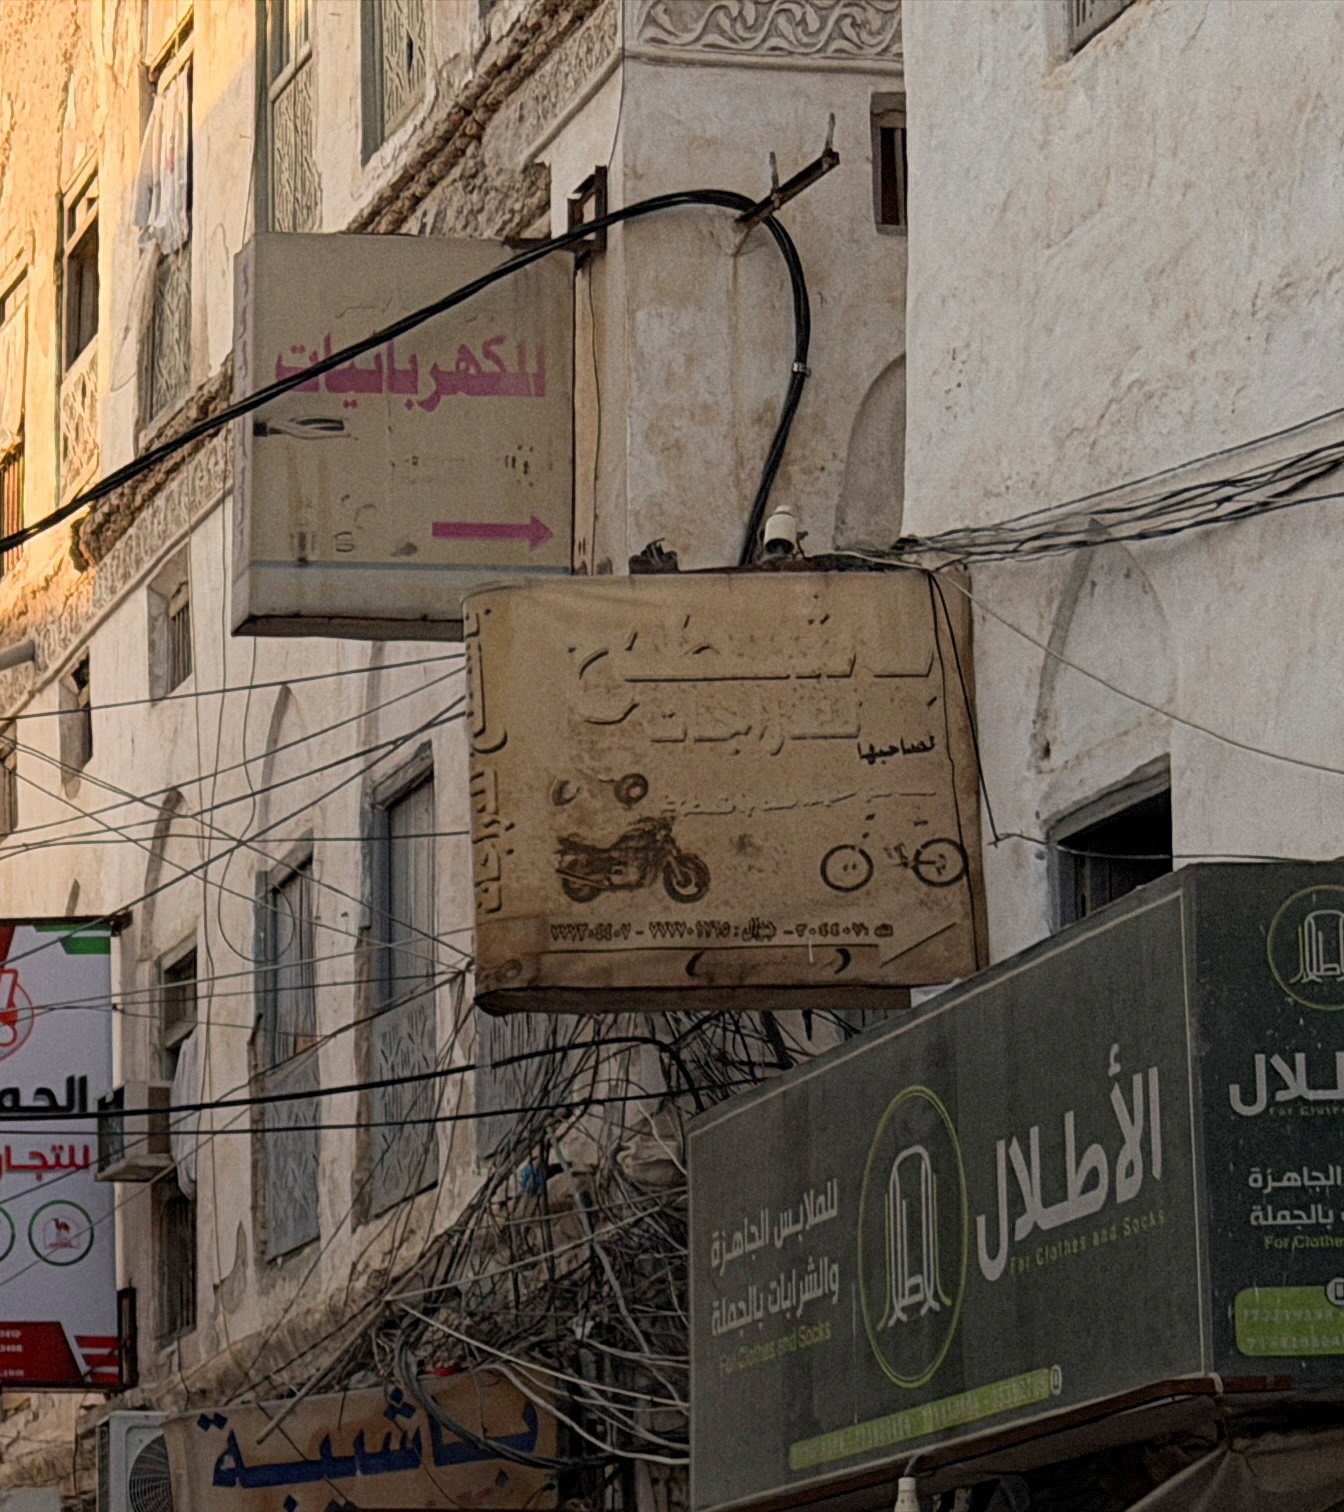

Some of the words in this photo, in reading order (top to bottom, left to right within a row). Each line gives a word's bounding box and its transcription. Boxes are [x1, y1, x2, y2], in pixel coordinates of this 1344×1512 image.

[976, 1043, 1163, 1283] الأطلال
[711, 1209, 770, 1280] الجاهزة
[773, 1179, 839, 1252] للملابس
